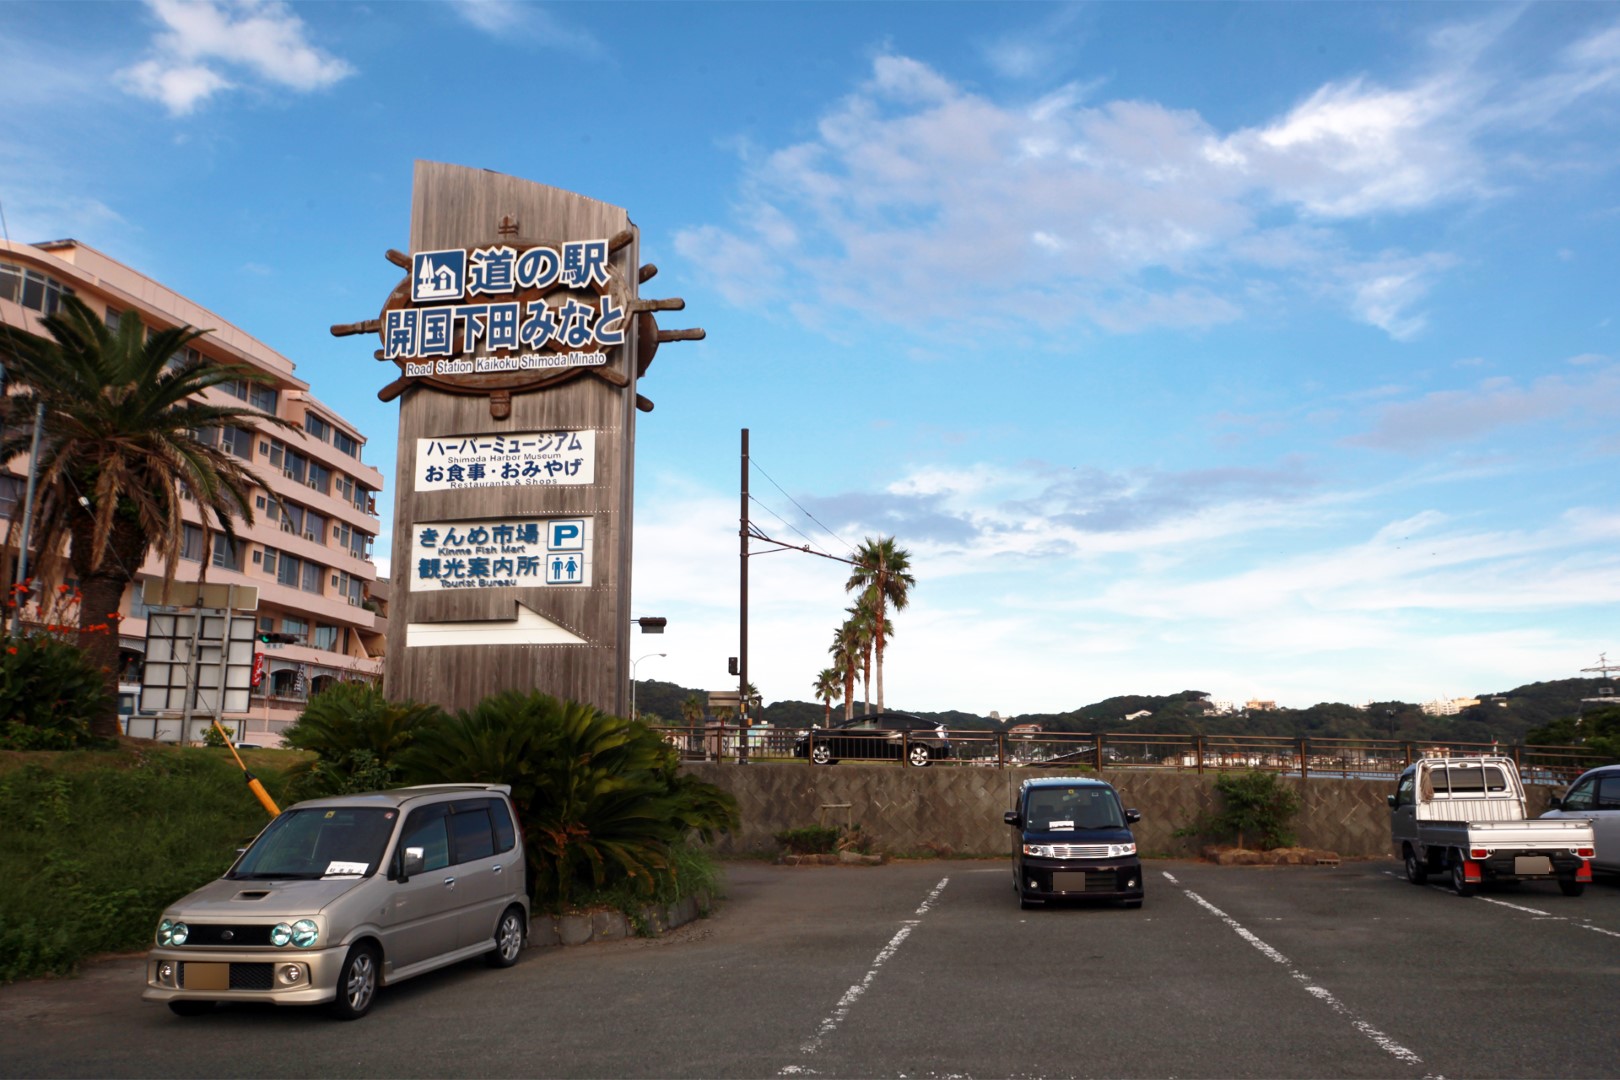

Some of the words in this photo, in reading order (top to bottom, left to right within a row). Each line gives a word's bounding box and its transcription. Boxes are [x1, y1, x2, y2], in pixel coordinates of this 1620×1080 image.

[466, 239, 611, 296] 道の駅
[384, 295, 625, 359] 開国下田みなと
[406, 361, 433, 375] Road
[437, 360, 472, 374] Station
[476, 357, 518, 371] Kaikoku
[521, 354, 567, 368] Shimoda
[569, 351, 605, 365] Minato
[427, 432, 583, 456] ハーバーミュージアム
[447, 456, 487, 464] Shimoda
[490, 454, 521, 462] Harbor
[524, 452, 562, 461] Museum
[425, 458, 584, 483] お食事・おみやげ
[450, 480, 511, 489] Restaurants
[514, 478, 521, 486] &
[525, 477, 558, 486] Shops
[419, 523, 540, 547] きんめ市場
[553, 525, 579, 546] P
[437, 547, 472, 556] Kinme
[475, 546, 498, 555] Fish
[501, 544, 526, 553] Mart
[418, 555, 540, 580] 観光案内所
[440, 578, 476, 588] Tourist
[478, 578, 517, 588] Bureau
